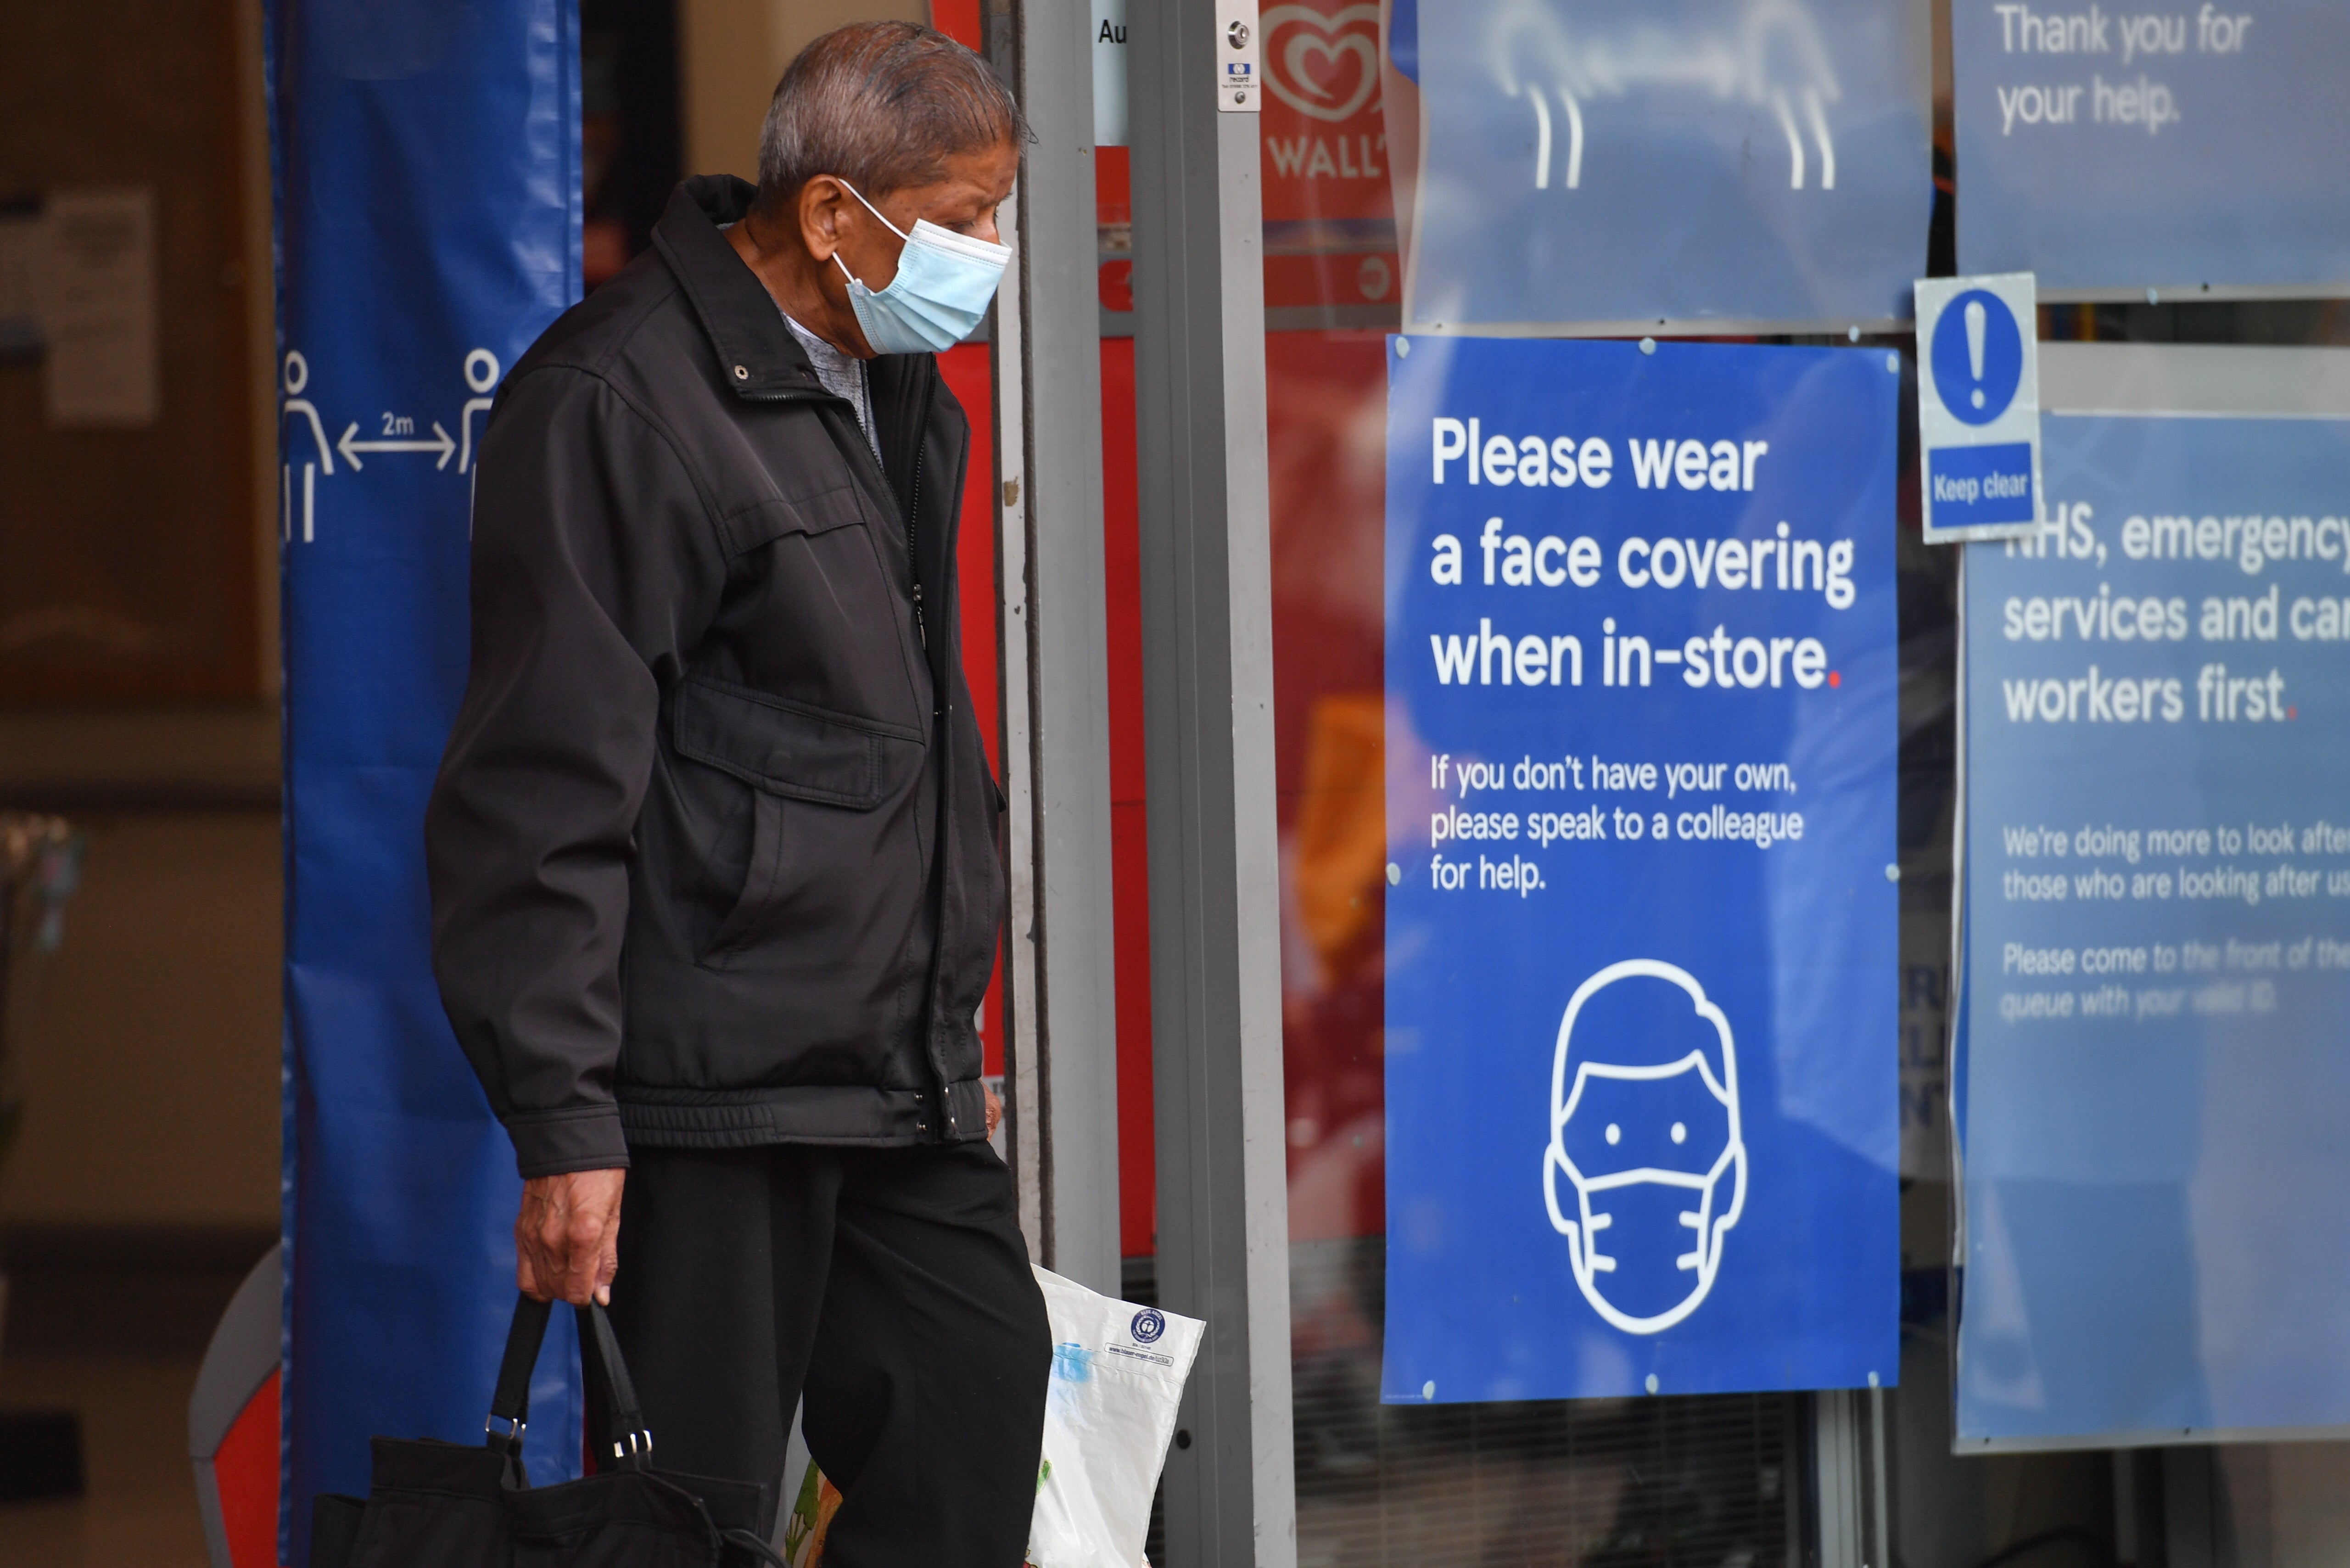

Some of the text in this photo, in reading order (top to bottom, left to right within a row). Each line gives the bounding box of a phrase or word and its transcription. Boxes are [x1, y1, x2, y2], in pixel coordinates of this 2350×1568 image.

[1994, 2, 2252, 63] Thank you for
[1997, 75, 2179, 135] your help.
[382, 411, 414, 436] 2m
[1432, 416, 1769, 491] Please wear
[1934, 471, 2028, 504] Keep clear
[1431, 517, 1856, 610] a face covering
[2003, 582, 2187, 641] services
[2199, 584, 2278, 640] and
[1430, 617, 1840, 689] when in-store.
[2002, 664, 2297, 722] workers first.
[1431, 754, 1449, 790] If
[1455, 762, 1505, 799] you
[1592, 755, 1658, 790] have
[1665, 763, 1728, 799] your
[1735, 763, 1797, 794] own,
[1431, 804, 1806, 849] please speak to a colleague
[2003, 826, 2068, 857] We're
[2074, 824, 2141, 863] doing
[2147, 830, 2210, 855] more
[2216, 826, 2242, 855] to
[2248, 823, 2294, 854] look
[1430, 853, 1546, 898] for help.
[2002, 869, 2068, 901] those
[2074, 868, 2125, 899] who
[2131, 873, 2172, 899] are
[2178, 866, 2260, 905] looking
[2265, 864, 2321, 896] after
[2003, 942, 2076, 975] Please
[2081, 947, 2147, 974] come
[2153, 943, 2177, 972] to
[1999, 992, 2074, 1024] queue
[2081, 985, 2129, 1015] with
